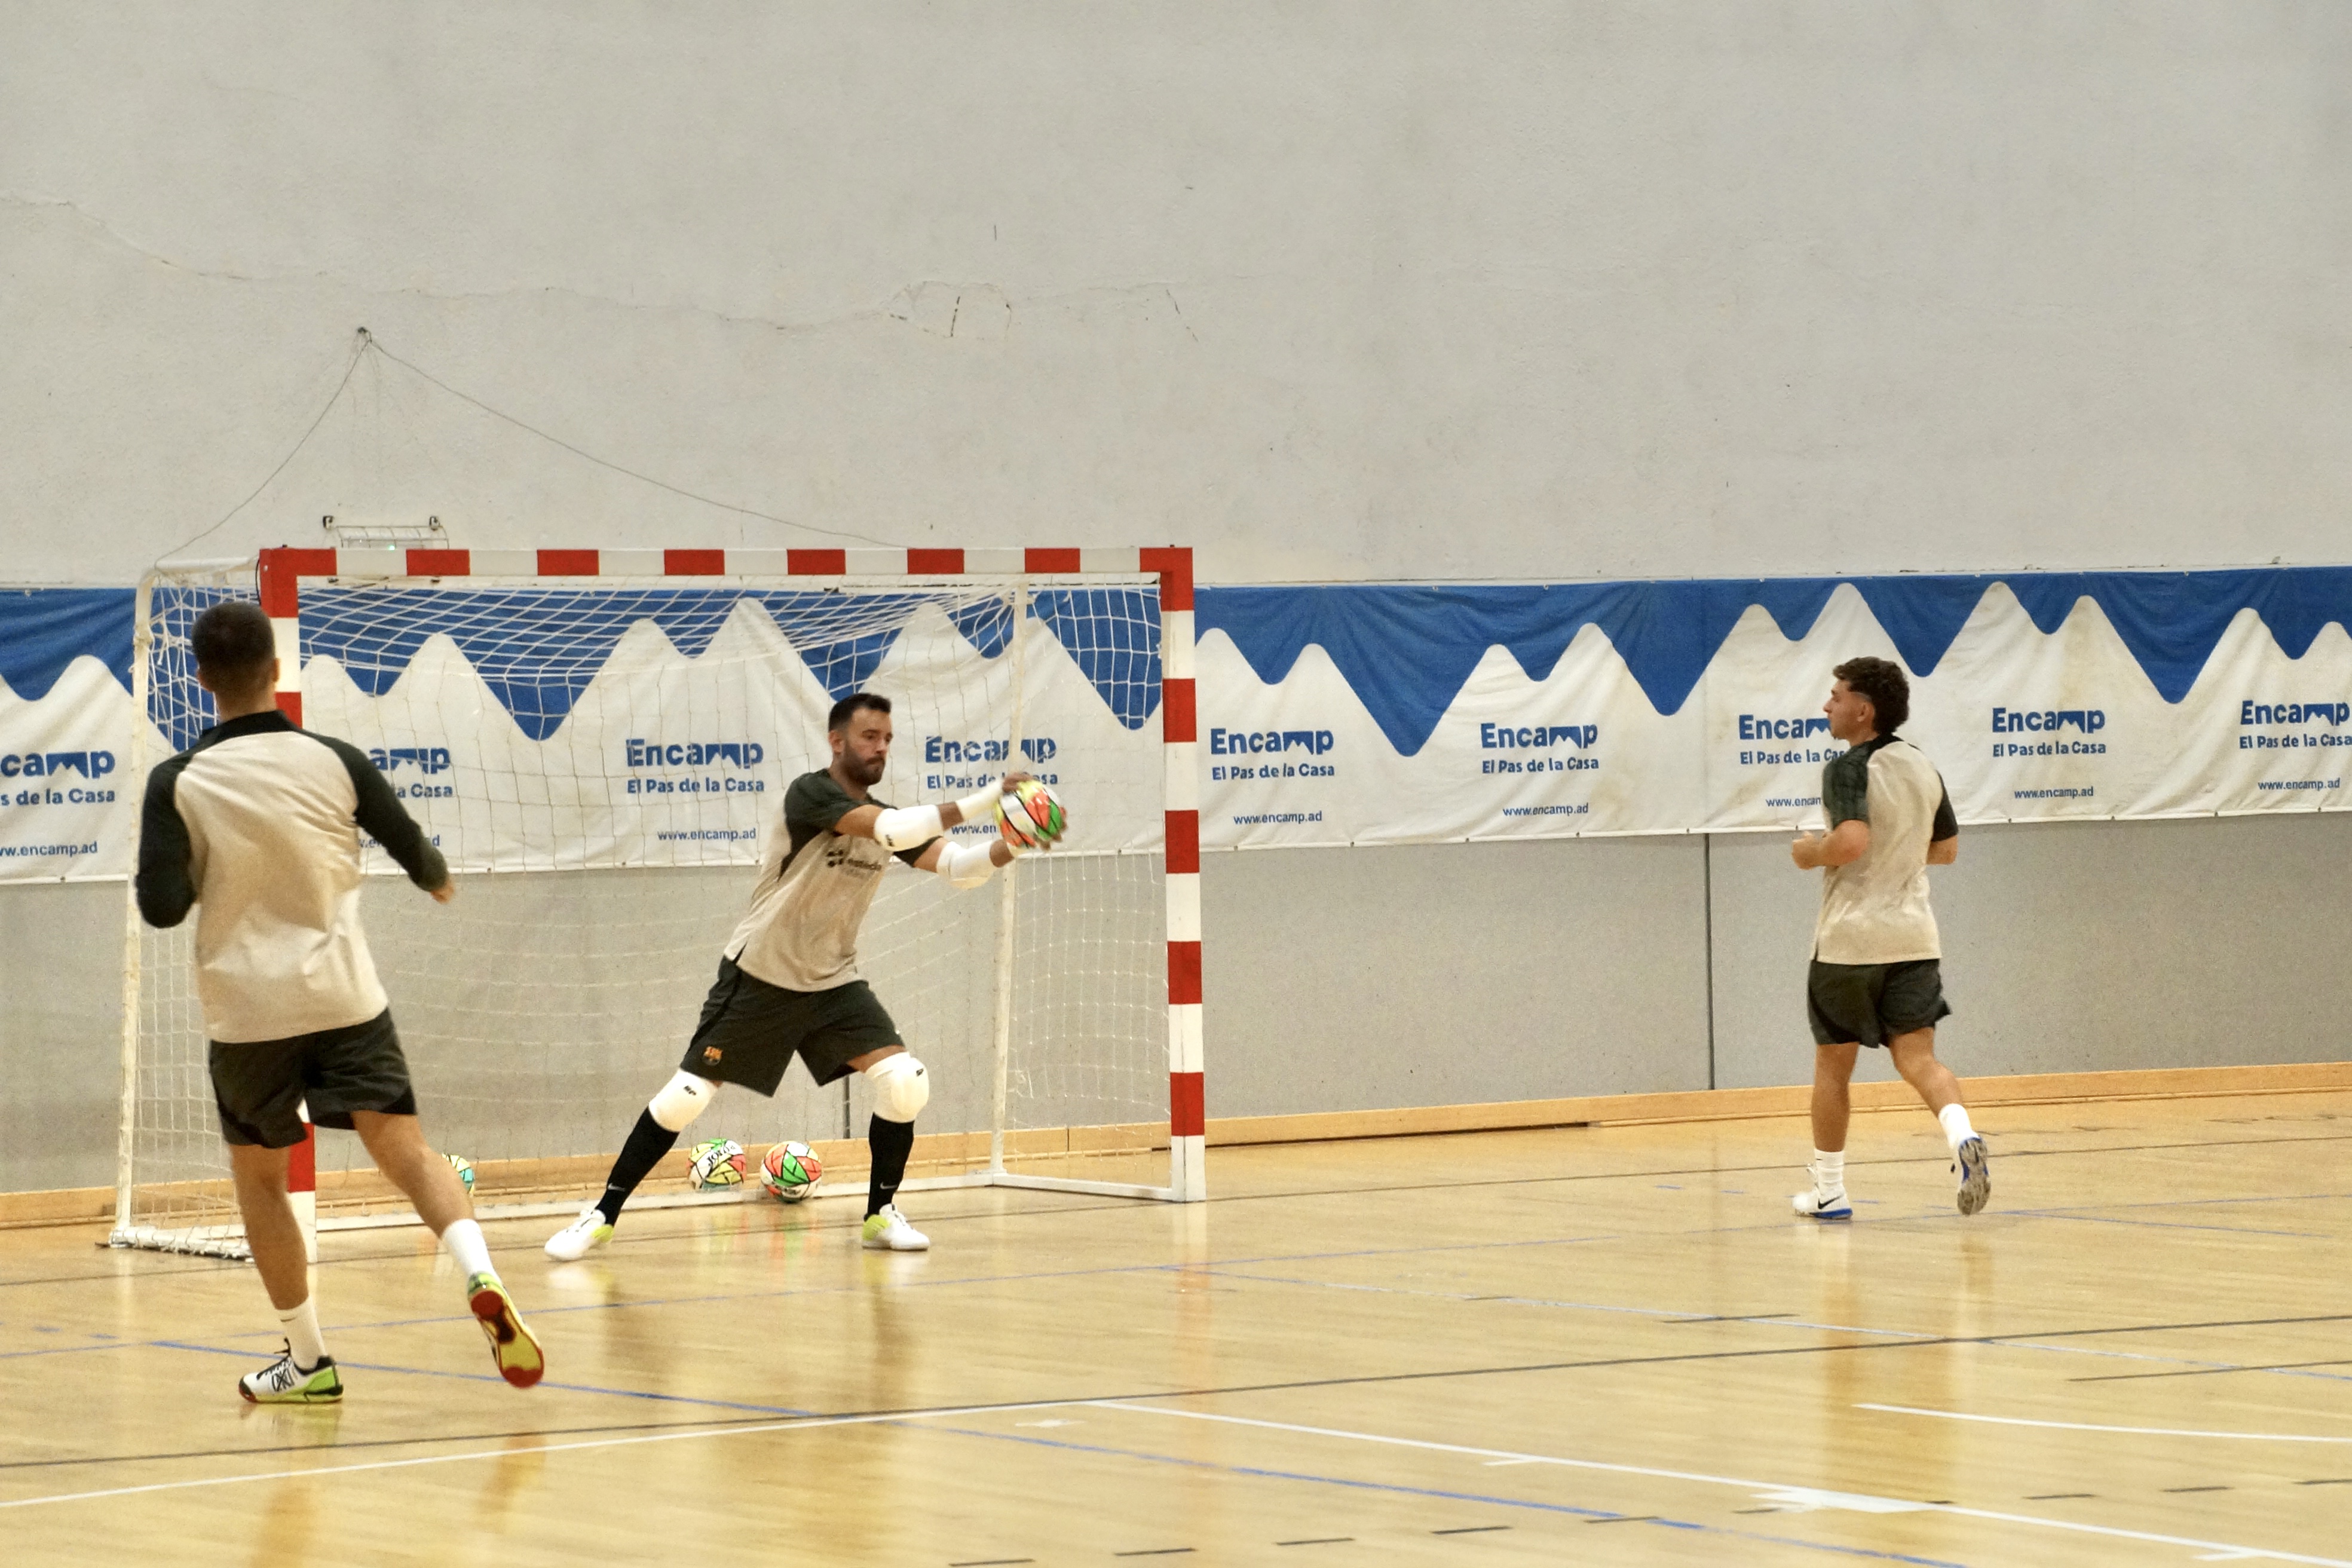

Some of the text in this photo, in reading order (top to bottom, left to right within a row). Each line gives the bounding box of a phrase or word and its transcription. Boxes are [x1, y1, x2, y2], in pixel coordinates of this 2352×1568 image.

[1992, 707, 2106, 734] Encamp
[2240, 700, 2351, 727] Encamp
[1480, 722, 1598, 749] Encamp
[1739, 714, 1831, 740] Encam
[1210, 728, 1334, 756] Encamp
[1993, 741, 2106, 758] El Pas de la Casa
[2239, 733, 2352, 749] El Pas de la Casa
[369, 748, 450, 775] amp
[626, 738, 764, 770] Encamp
[1740, 748, 1845, 765] El Pas de la Cas
[0, 751, 115, 779] camp
[1212, 762, 1335, 781] El Pas de la Casa
[1482, 757, 1599, 774] El Pas de la Casa
[627, 776, 765, 794] El Pas de la Casa
[927, 774, 941, 789] El
[945, 774, 972, 789] Pas
[2258, 777, 2341, 791] www.encamp.ad
[16, 790, 40, 806] de
[45, 788, 63, 804] la
[68, 788, 115, 804] Casa
[410, 783, 453, 798] Casa
[2014, 786, 2094, 799] www.encamp.ad
[1233, 810, 1322, 825] www.encamp.ad
[1502, 803, 1589, 817] www.encamp.ad
[658, 828, 756, 841] www.encamp.ad
